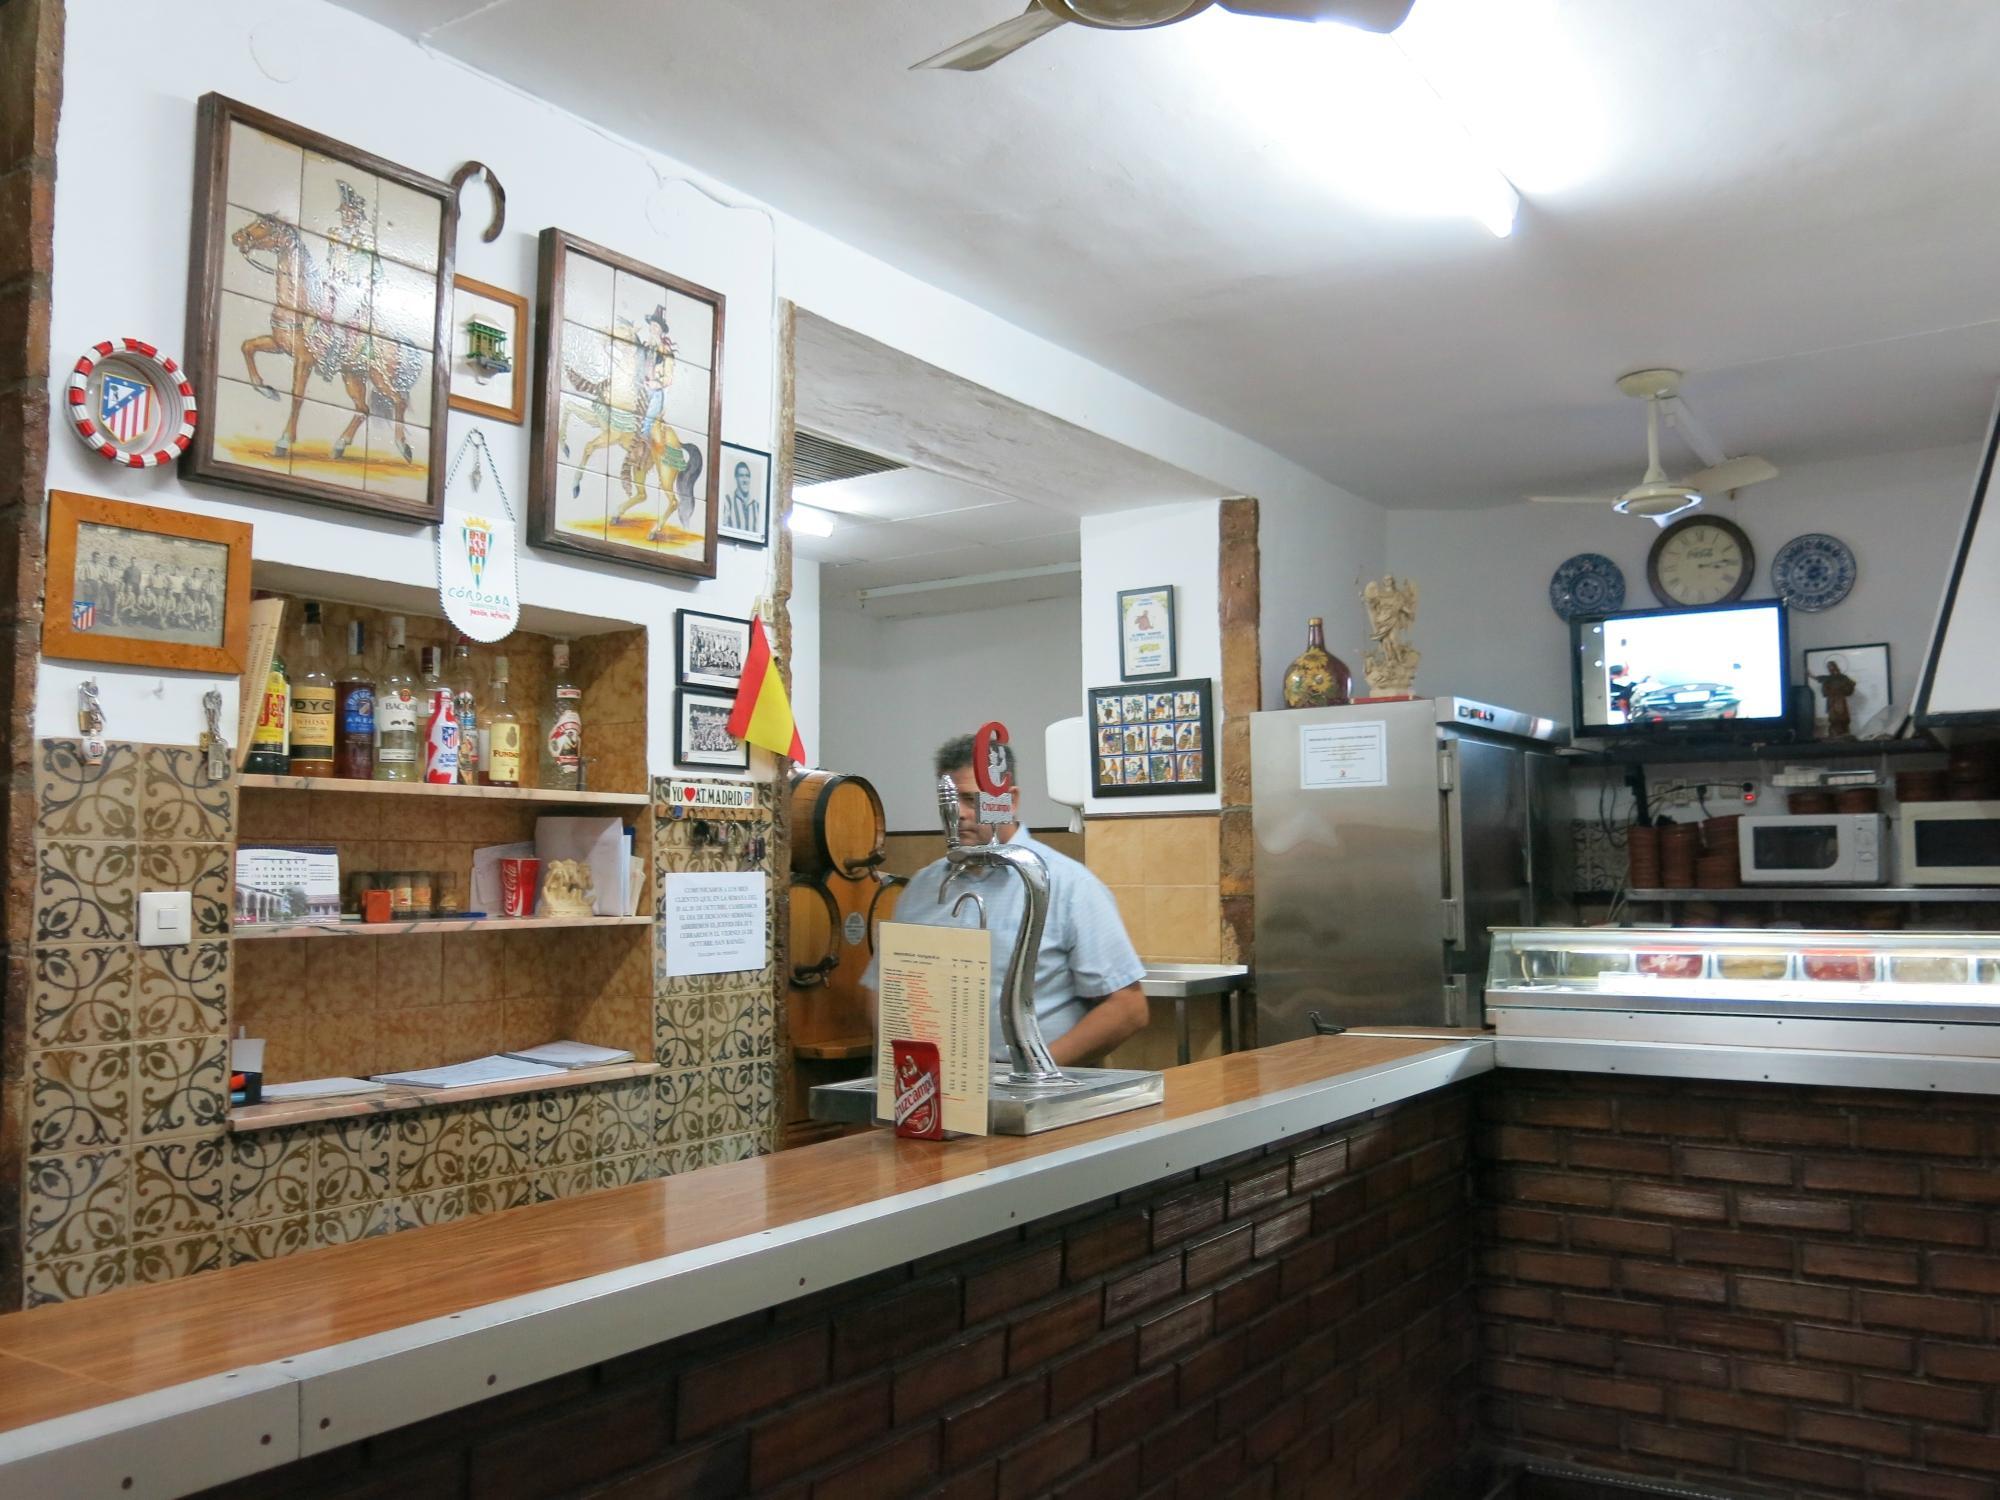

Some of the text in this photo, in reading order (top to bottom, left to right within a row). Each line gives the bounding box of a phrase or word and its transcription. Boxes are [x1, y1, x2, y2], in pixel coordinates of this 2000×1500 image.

[448, 586, 510, 607] CÓRDOBA
[295, 700, 331, 711] DYC
[672, 786, 683, 802] YO
